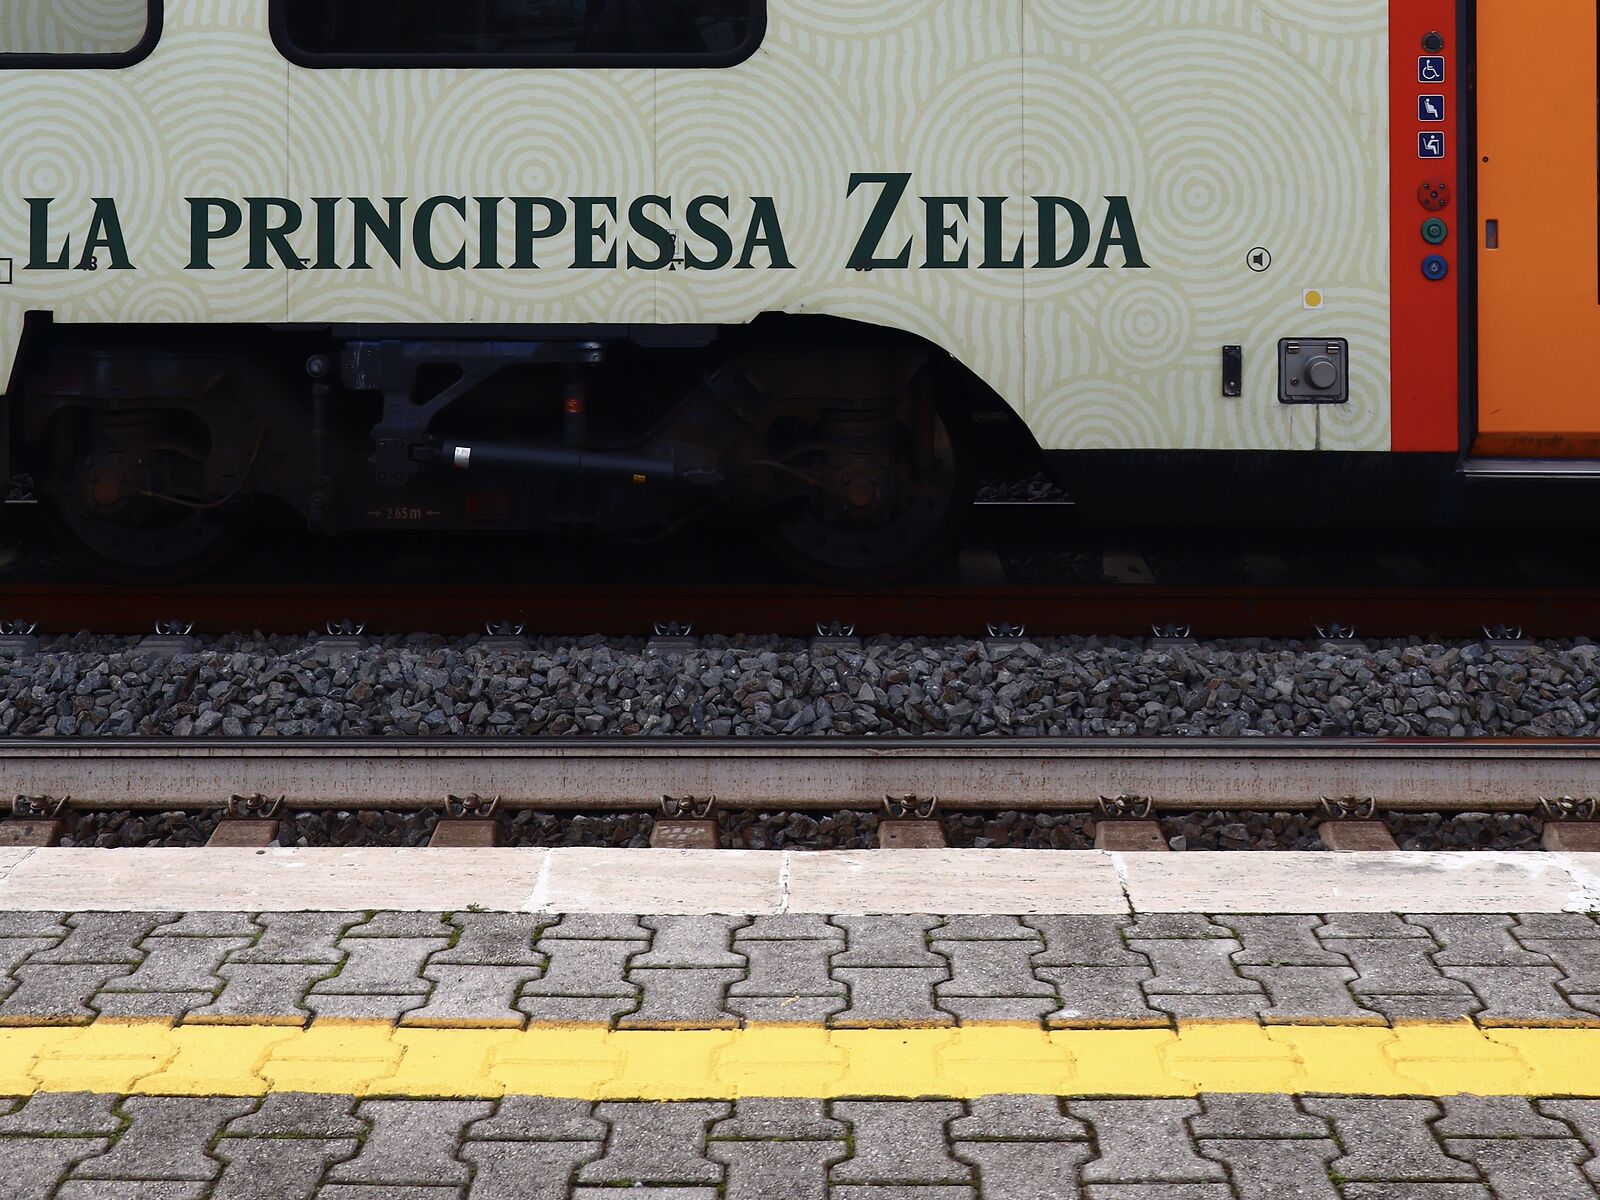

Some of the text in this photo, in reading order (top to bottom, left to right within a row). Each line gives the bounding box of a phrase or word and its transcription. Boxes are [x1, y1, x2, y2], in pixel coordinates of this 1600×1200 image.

[23, 172, 1152, 270] LA PRINCIPESSA ZELDA
